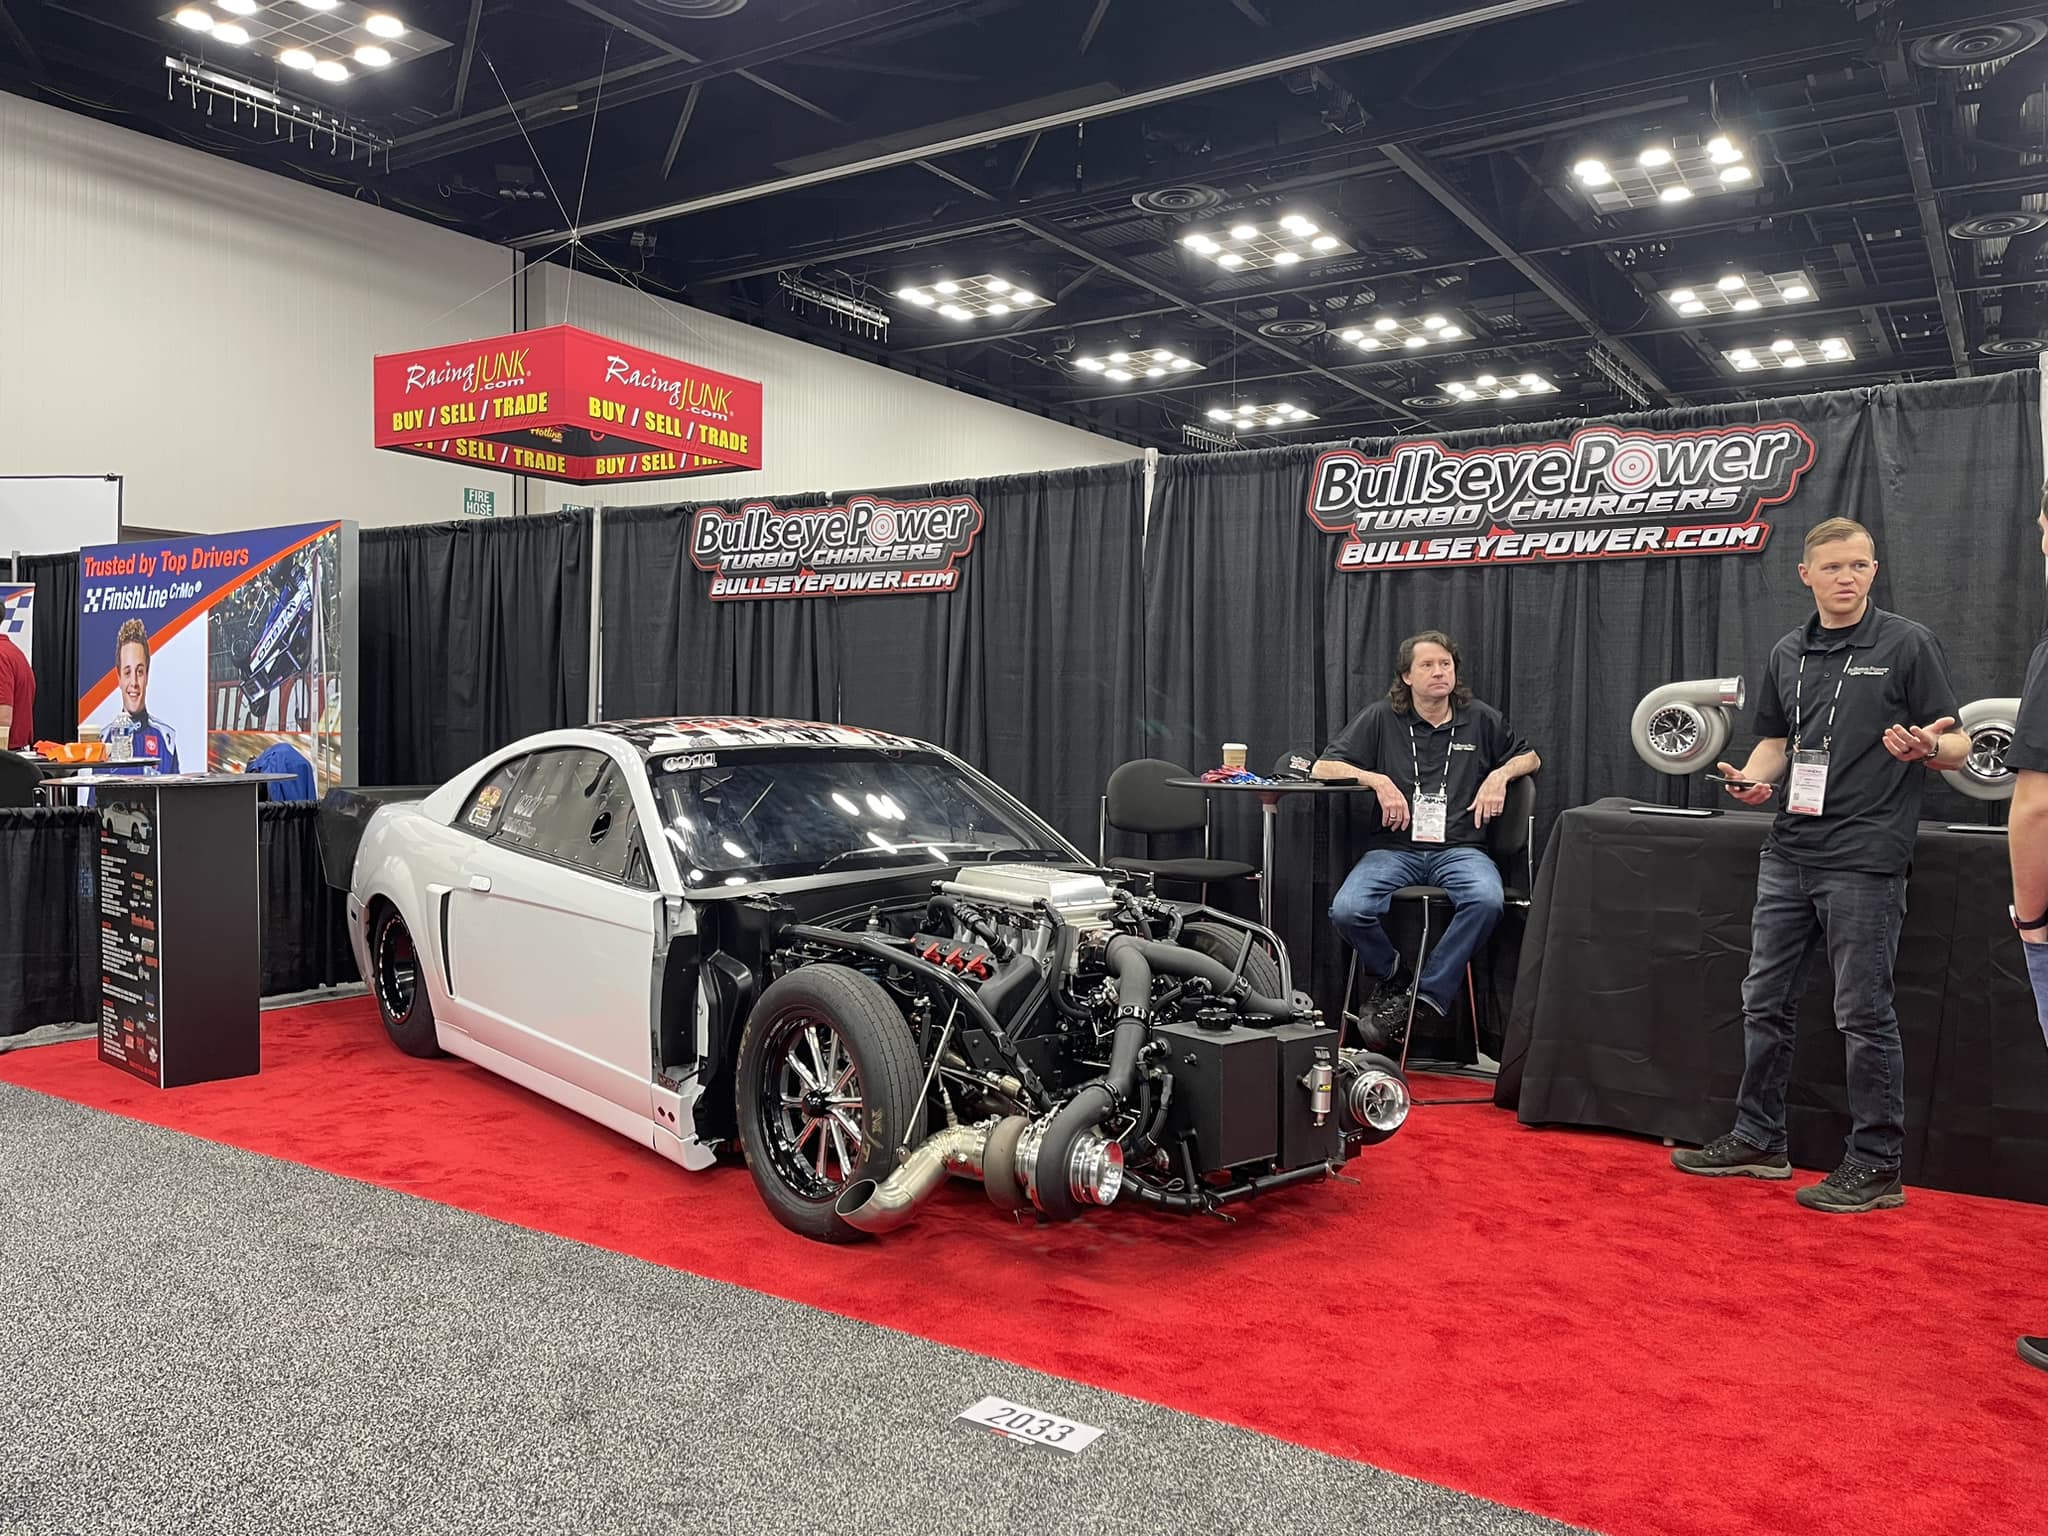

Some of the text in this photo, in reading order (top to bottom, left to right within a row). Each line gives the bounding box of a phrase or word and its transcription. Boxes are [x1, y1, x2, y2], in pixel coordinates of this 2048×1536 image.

[479, 378, 525, 391] .com
[392, 408, 424, 431] BUY
[440, 402, 476, 425] SELL
[493, 392, 548, 418] TRADE
[588, 396, 626, 424] BUY
[644, 411, 682, 438] SELL
[699, 424, 748, 453] TRADE
[686, 407, 728, 421] .com
[456, 438, 496, 462] SELL
[513, 448, 567, 473] TRADE
[595, 457, 626, 475] BUY
[641, 453, 676, 471] SELL
[466, 501, 493, 516] HOSE
[468, 489, 490, 503] FIRE
[1355, 487, 1743, 531] TURBO CHARGERS
[84, 546, 249, 577] Trusted by Top Drivers
[719, 543, 944, 570] TURBO CHARGERS
[102, 584, 168, 611] FinishLine
[985, 1407, 1075, 1442] 2033
